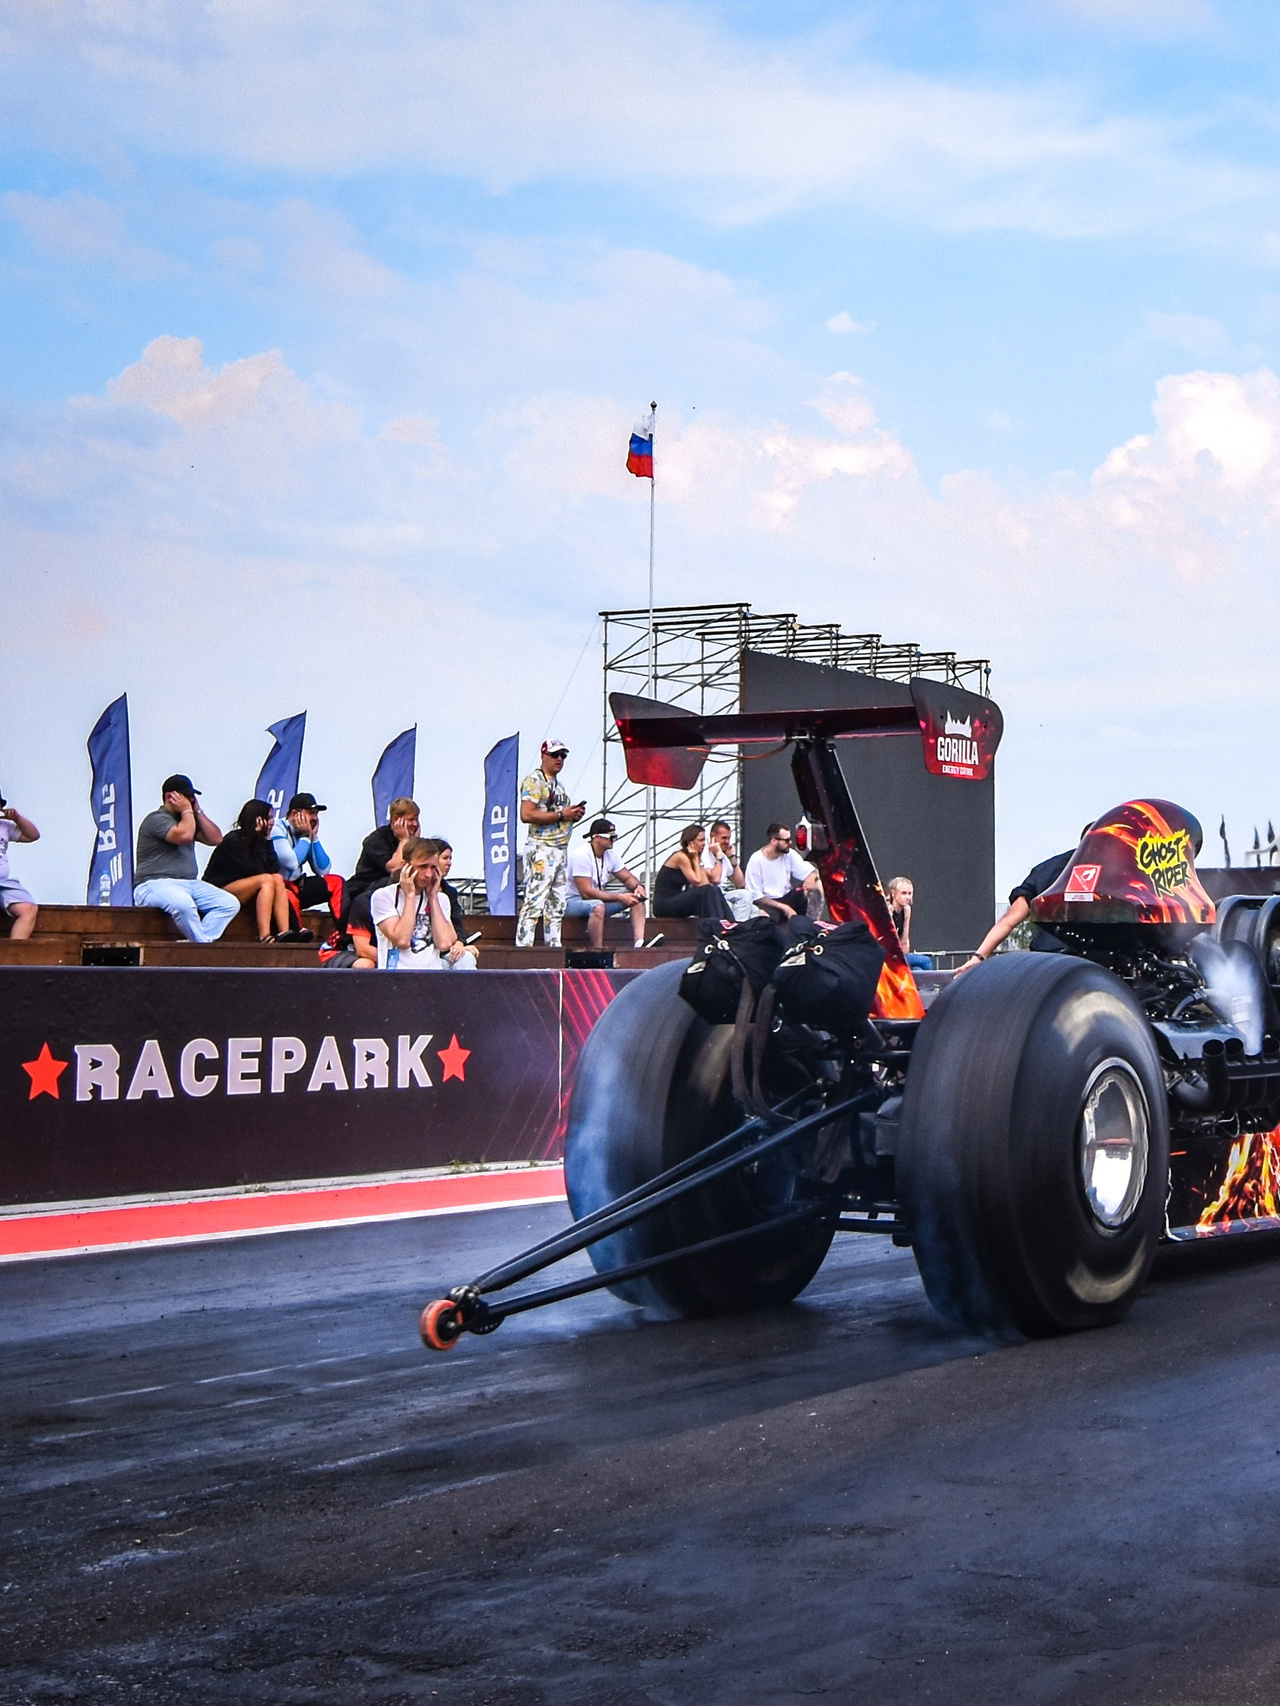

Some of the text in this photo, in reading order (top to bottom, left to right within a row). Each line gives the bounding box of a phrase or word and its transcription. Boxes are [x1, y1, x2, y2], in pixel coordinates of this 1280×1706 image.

[937, 736, 979, 765] GORILLA
[1140, 836, 1184, 869] GHOST
[1151, 861, 1192, 898] RIDER
[74, 1034, 434, 1101] RACEPARK
